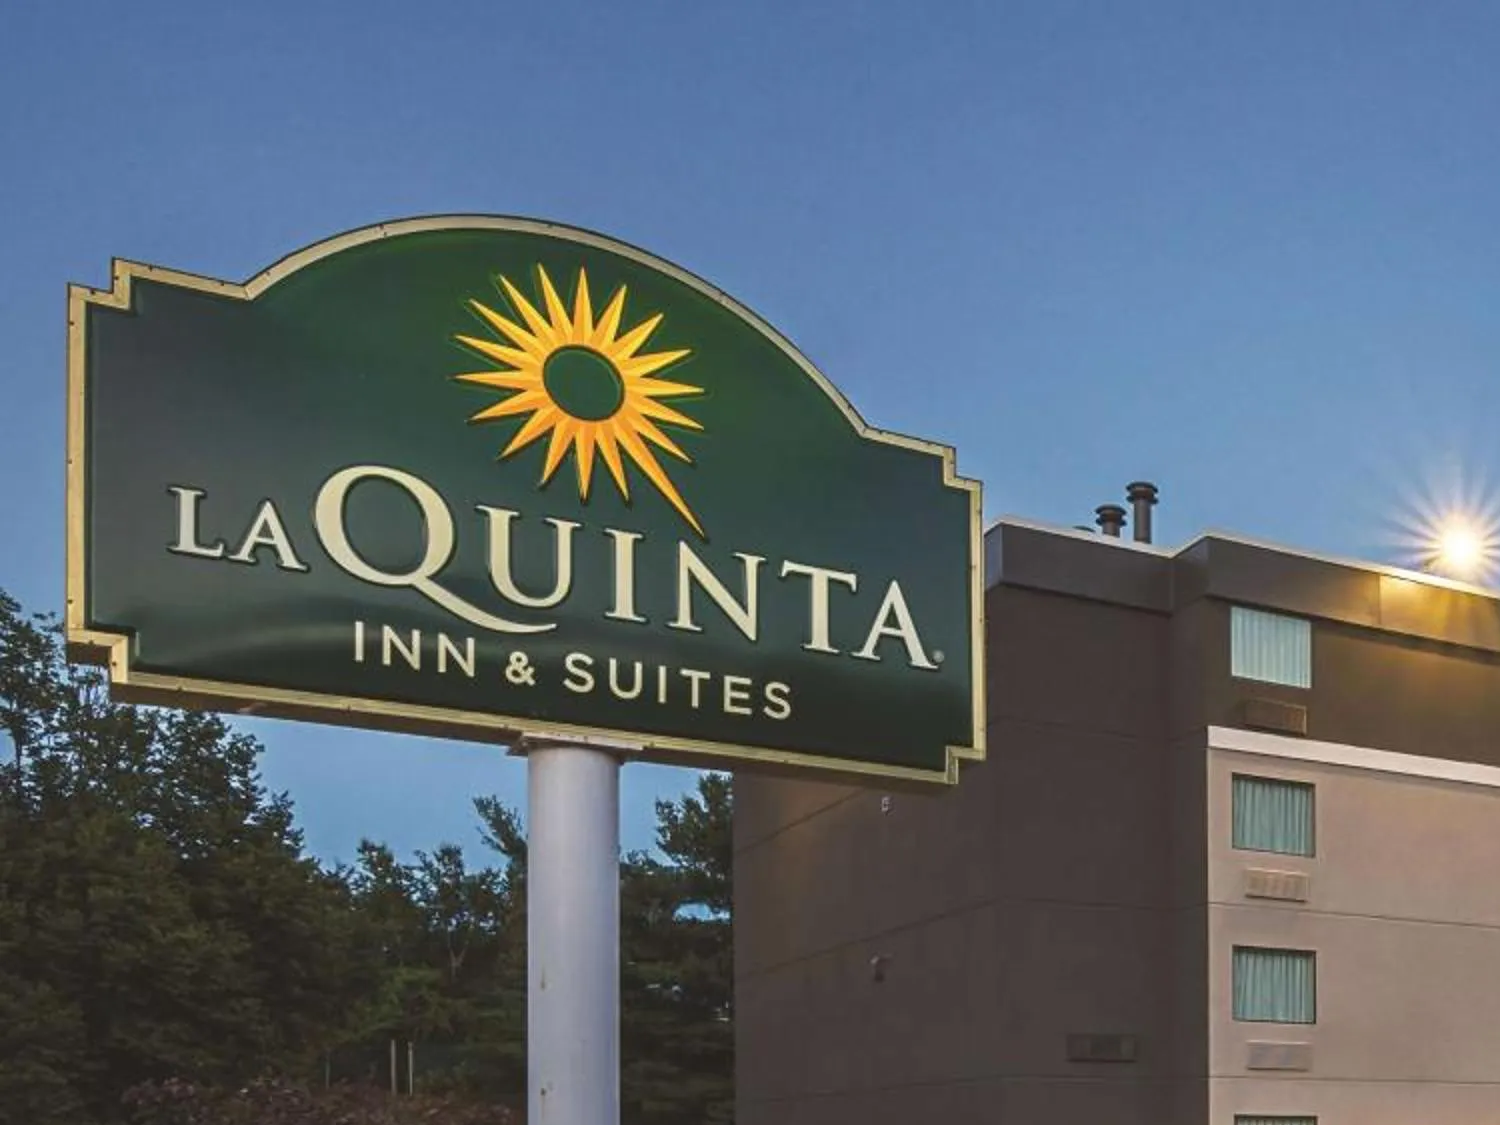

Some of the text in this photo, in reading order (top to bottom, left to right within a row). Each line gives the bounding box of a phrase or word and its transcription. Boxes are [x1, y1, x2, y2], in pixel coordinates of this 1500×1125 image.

[169, 466, 939, 669] LA QUINTA
[353, 620, 793, 720] INN & SUITES
